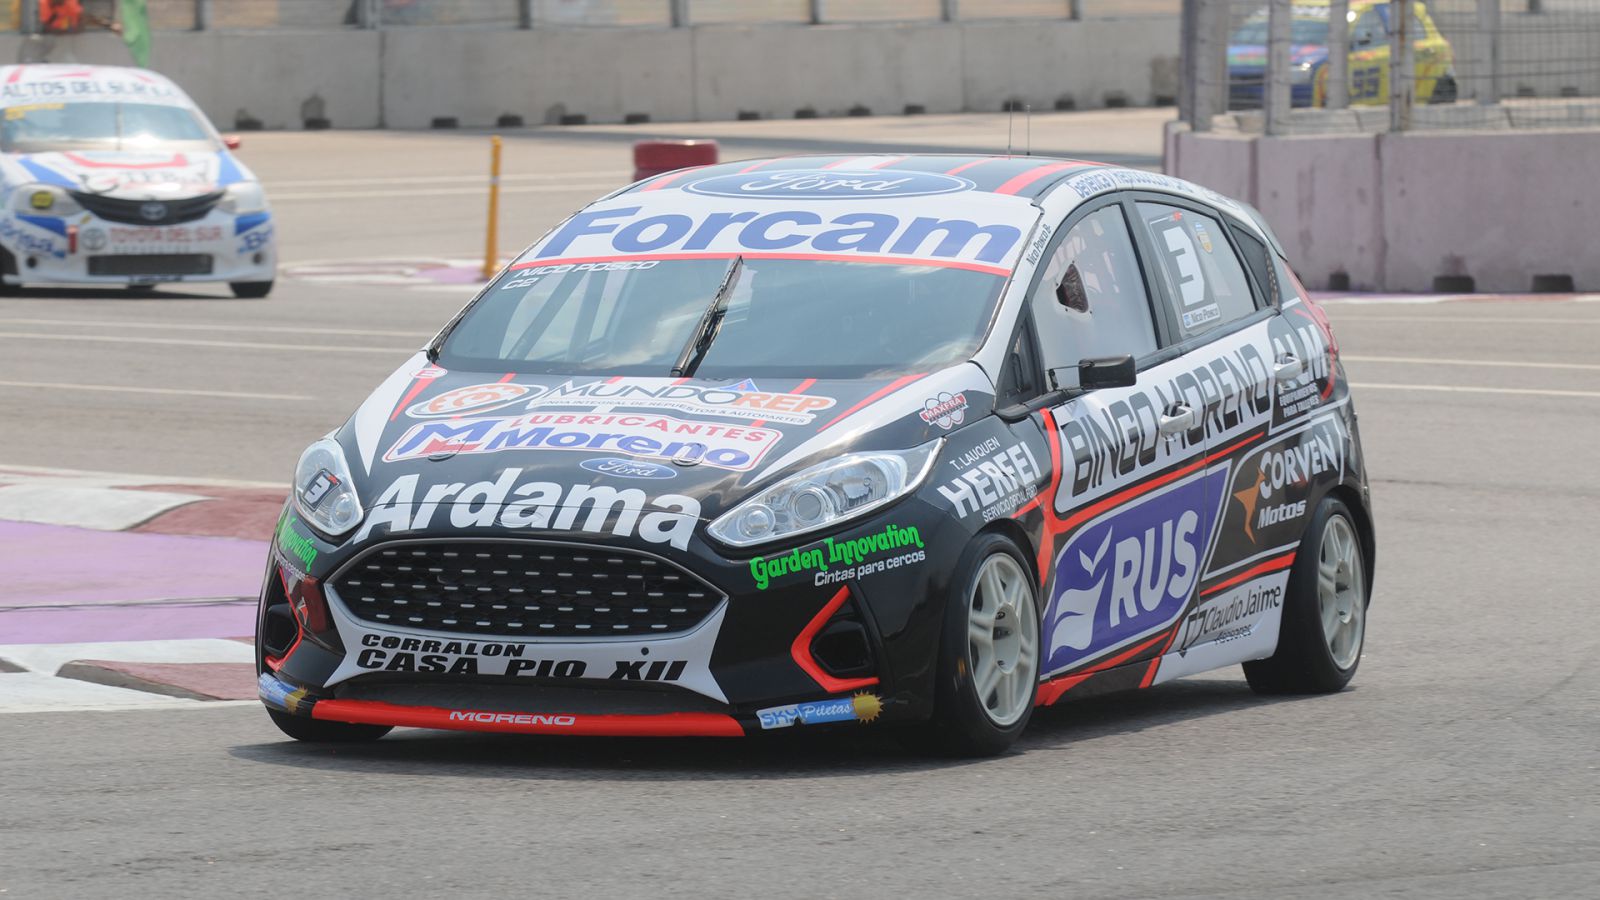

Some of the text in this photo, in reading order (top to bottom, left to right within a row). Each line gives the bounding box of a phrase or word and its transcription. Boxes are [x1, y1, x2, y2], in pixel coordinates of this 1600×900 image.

[741, 171, 895, 192] Ford
[535, 205, 1022, 264] Forcam
[513, 260, 661, 279] NICO POSCO
[1163, 226, 1205, 306] 3
[542, 382, 829, 412] MUNDOREP
[510, 415, 767, 442] LUBRICANTES
[728, 410, 806, 423] AUTOPARTES
[484, 427, 751, 466] Moreno
[958, 436, 1001, 467] LAUQUEN
[1060, 391, 1159, 497] BINGO
[598, 460, 659, 478] Ford
[1260, 425, 1339, 499] CORVEN
[304, 474, 331, 505] 3
[937, 441, 1041, 519] HERFEI
[353, 467, 703, 552] Ardama
[1258, 500, 1307, 529] Motos
[749, 524, 924, 590] Garden Innovation
[815, 550, 926, 587] Cintas para cercos
[1109, 510, 1198, 628] RUS
[1203, 585, 1281, 635] Claudio Jaime
[361, 633, 526, 657] CORRALON
[356, 648, 688, 681] CASA PIO XII
[450, 711, 576, 726] MORENO
[802, 702, 851, 718] Piletas
